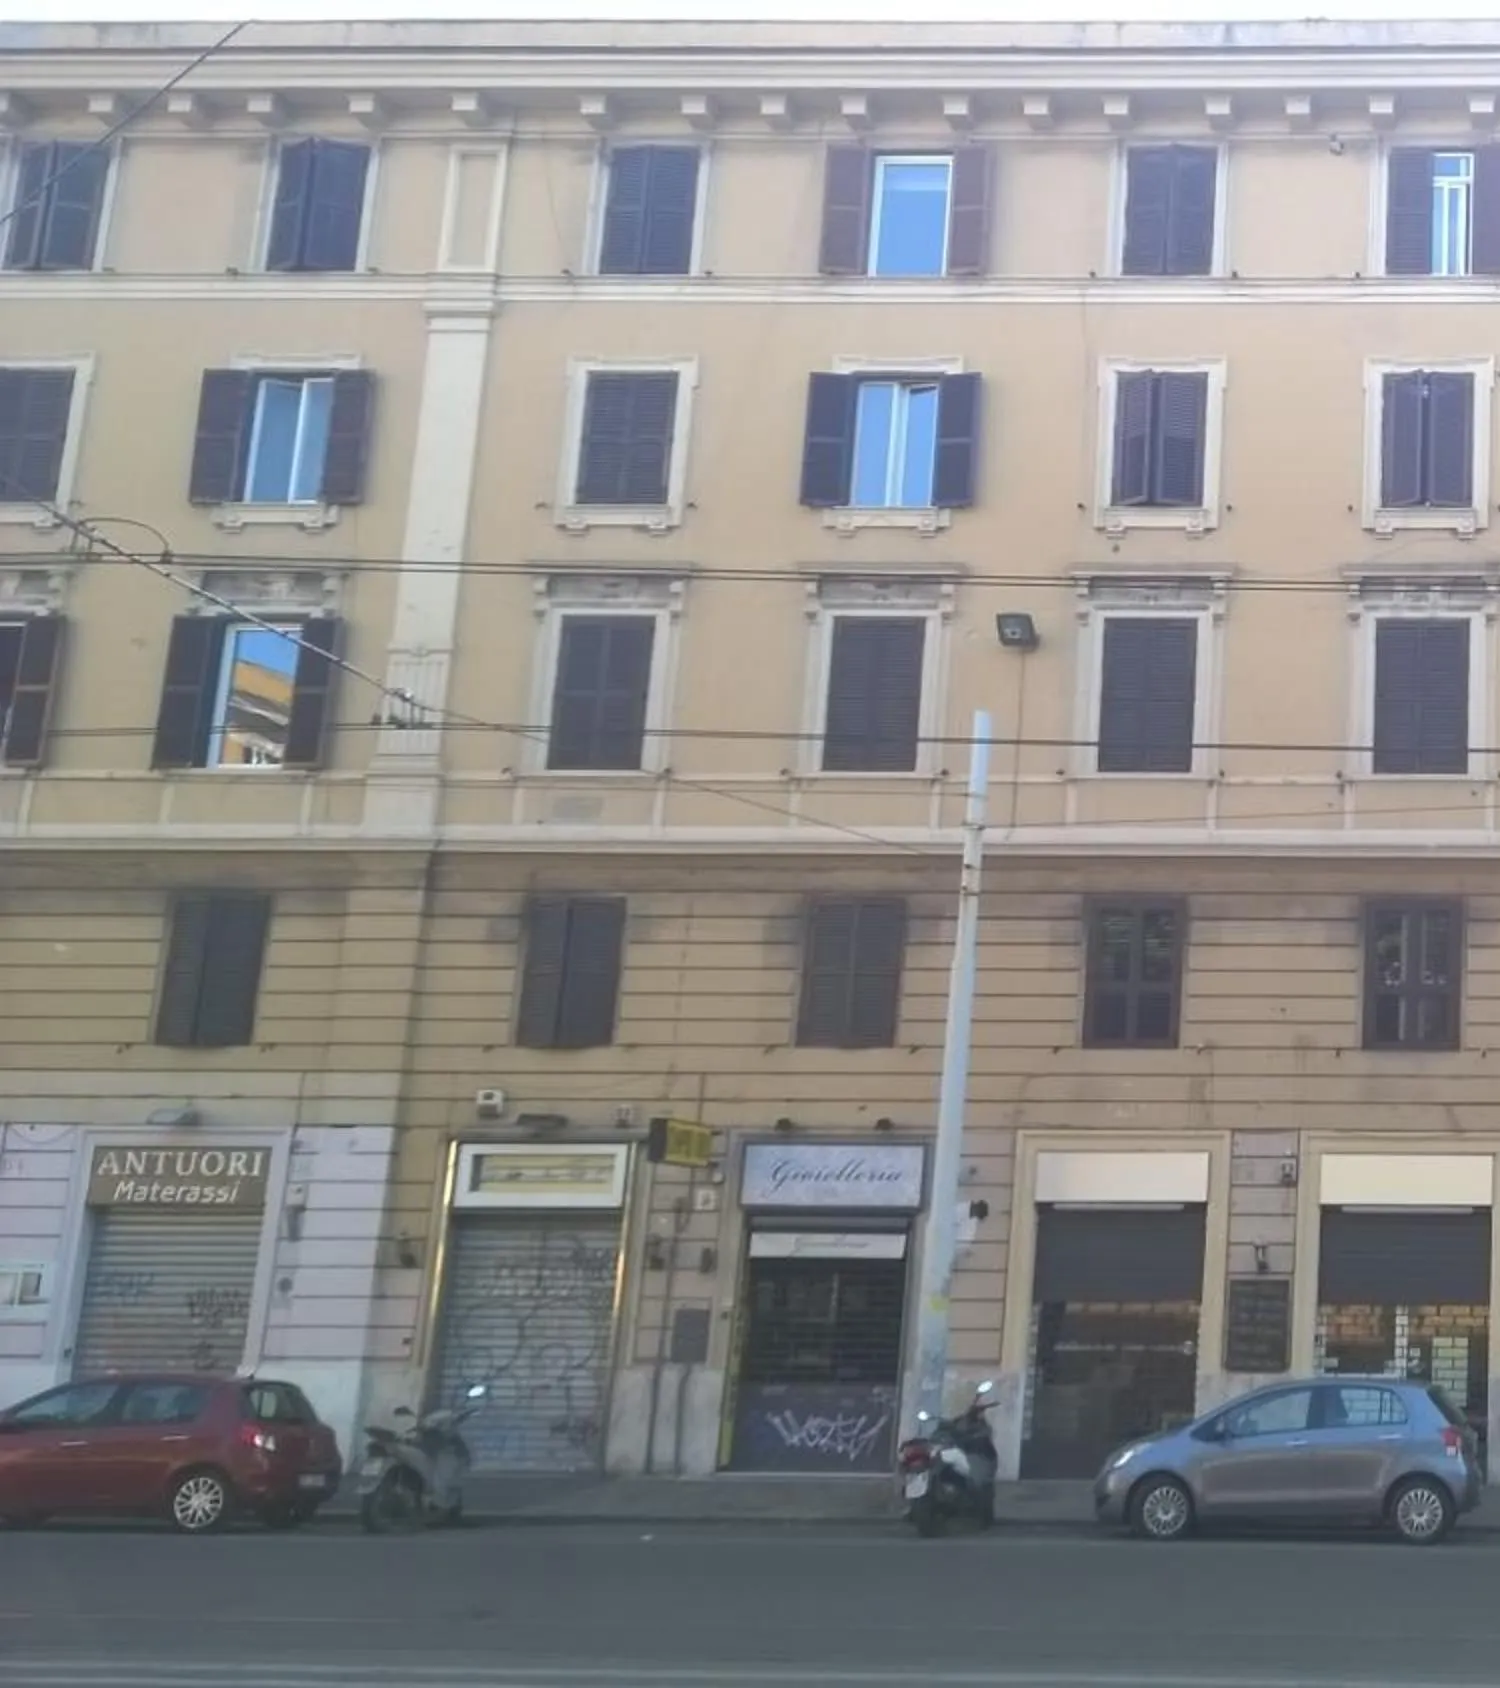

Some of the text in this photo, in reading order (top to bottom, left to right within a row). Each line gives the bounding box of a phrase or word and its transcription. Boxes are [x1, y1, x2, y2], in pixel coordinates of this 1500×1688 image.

[96, 1150, 264, 1177] ANTUORI
[765, 1158, 903, 1193] Gioielleria
[113, 1179, 241, 1204] Materassi
